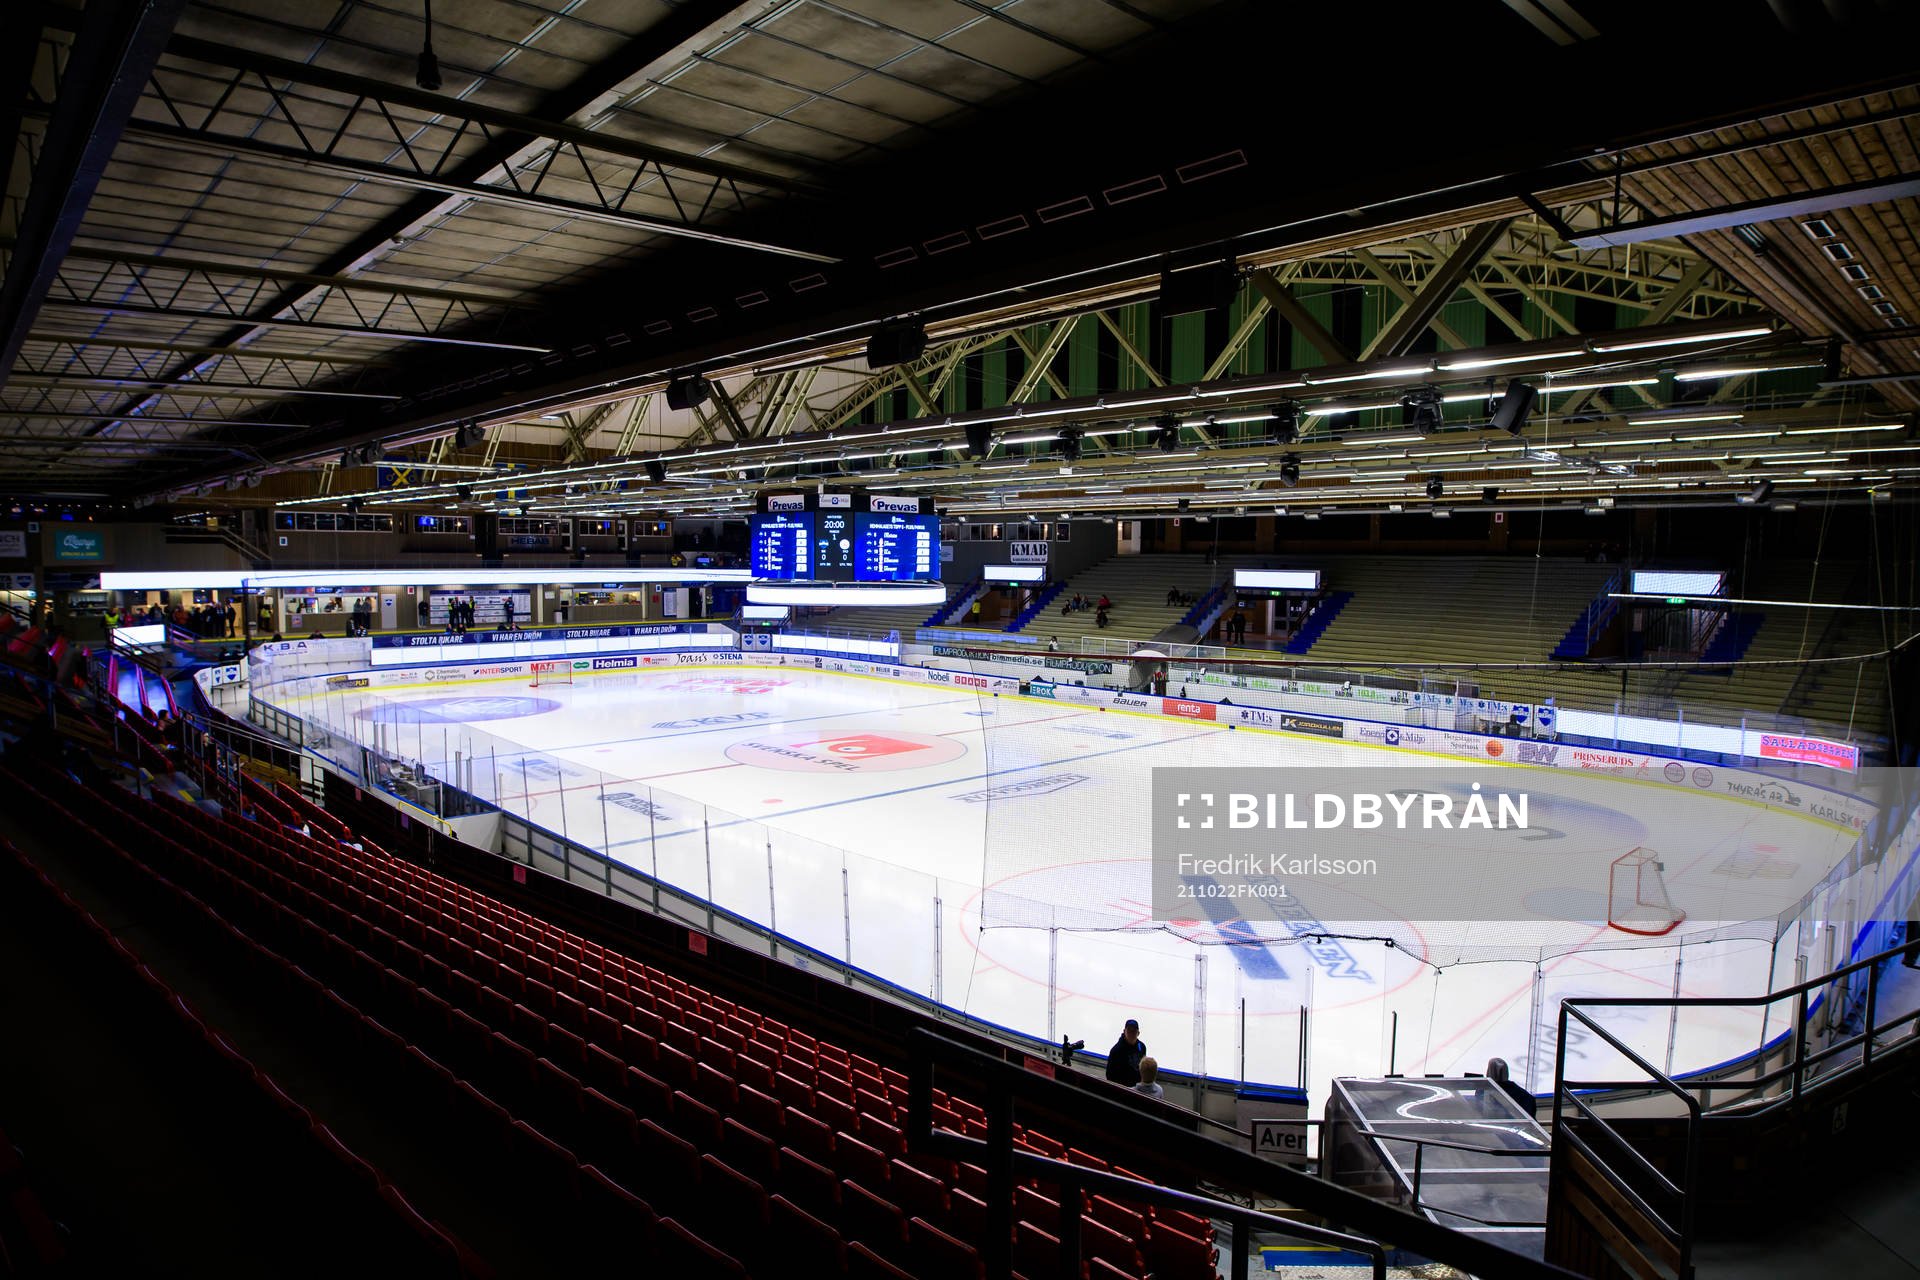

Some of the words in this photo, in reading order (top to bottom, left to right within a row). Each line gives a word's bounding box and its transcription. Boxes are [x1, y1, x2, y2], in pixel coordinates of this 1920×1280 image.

[771, 500, 804, 511] Prevas
[877, 500, 918, 512] Prevas
[824, 520, 845, 529] 20:00
[1011, 543, 1048, 556] KMAB
[500, 633, 513, 641] HAR
[514, 632, 523, 641] EN
[523, 630, 543, 640] DRÖM
[566, 629, 589, 639] STOLTA
[634, 627, 640, 635] VI
[640, 626, 653, 634] HAR
[410, 636, 438, 646] STOLTA
[595, 658, 634, 669] Helmia
[674, 653, 709, 666] Joan's
[479, 665, 523, 676] INTERSPORT
[927, 670, 950, 682] Nobeli
[1177, 703, 1201, 714] renta
[1250, 710, 1273, 724] TM:s
[1573, 751, 1634, 767] PRINSERUDS
[1727, 781, 1766, 799] THYRAS
[1809, 803, 1868, 835] KARLSKOG
